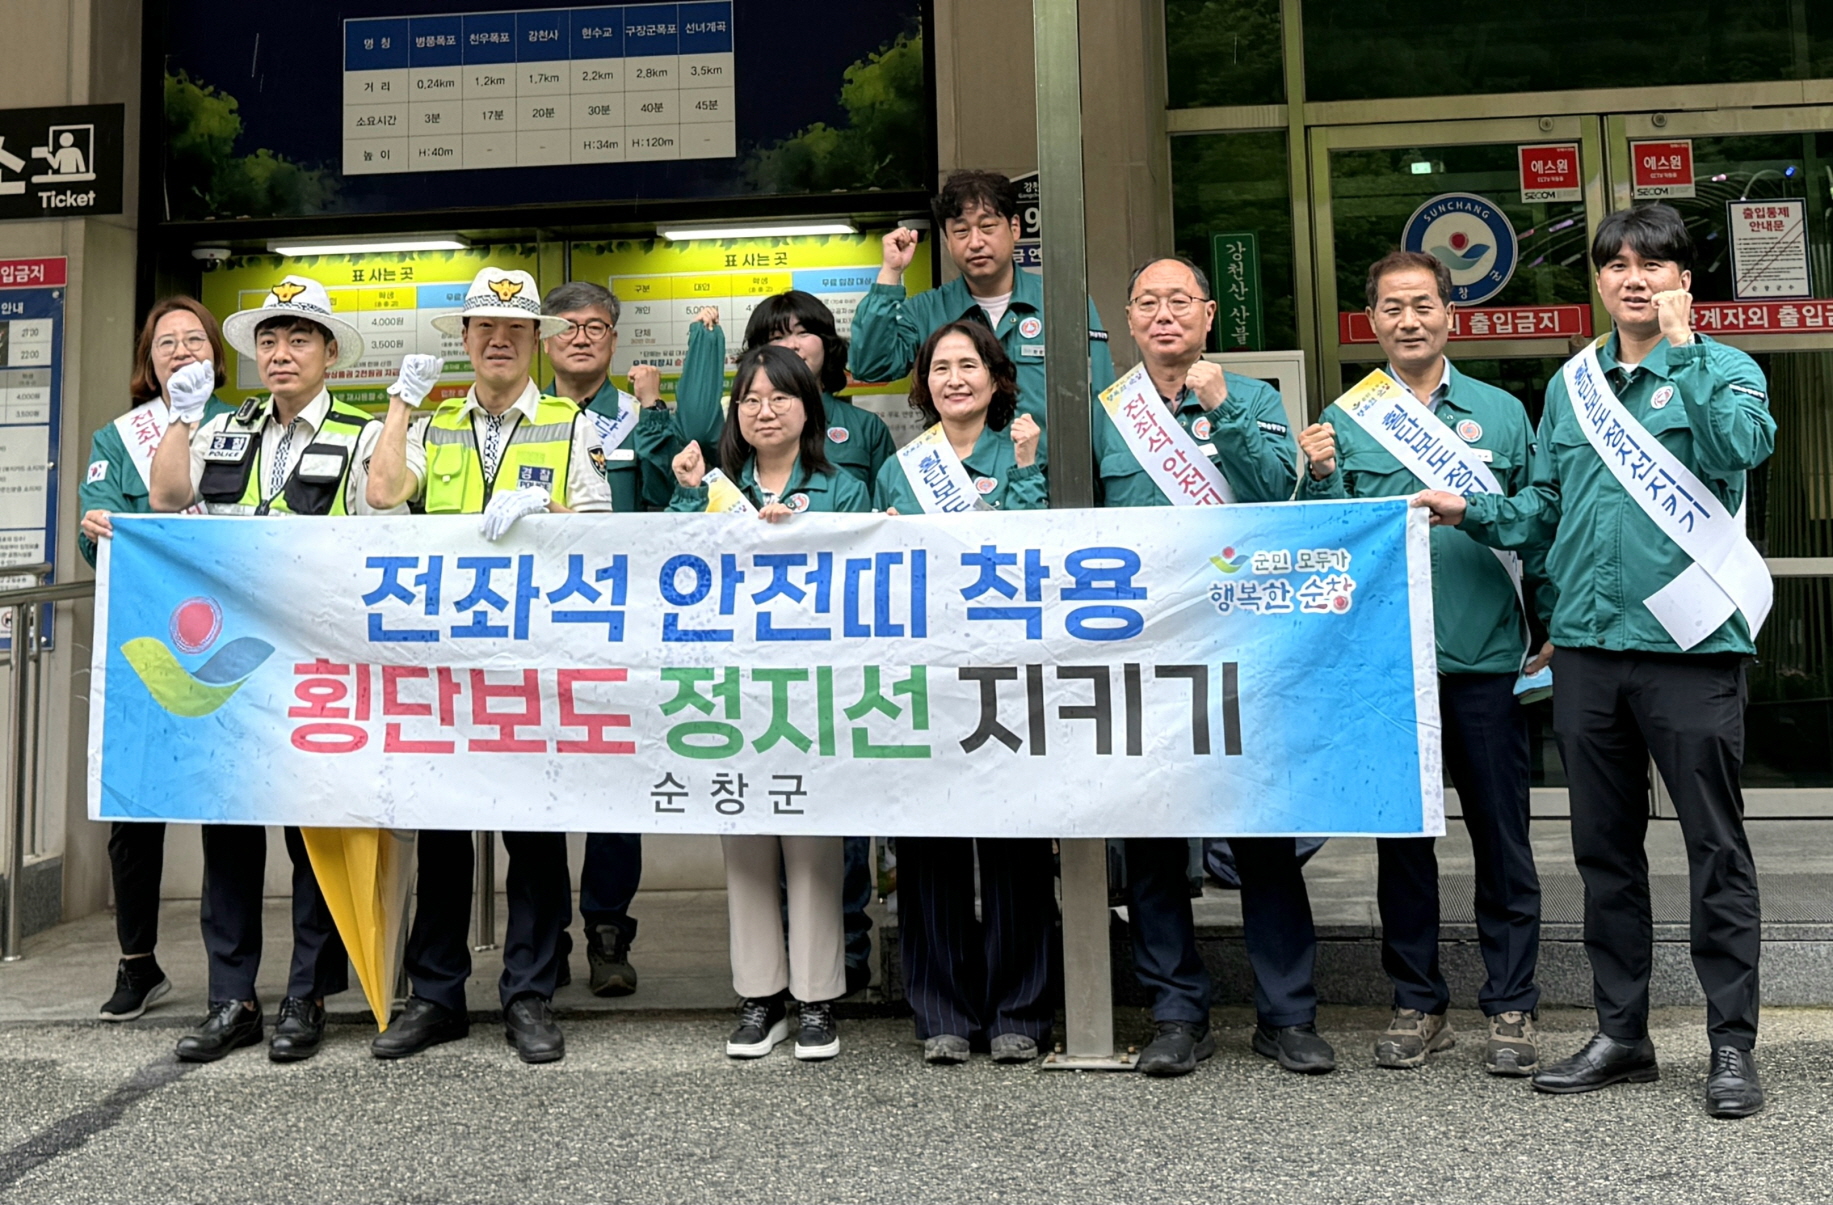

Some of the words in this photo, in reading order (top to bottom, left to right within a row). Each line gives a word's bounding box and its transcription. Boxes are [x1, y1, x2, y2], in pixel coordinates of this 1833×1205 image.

[528, 29, 559, 42] 강천사
[581, 27, 613, 39] 현수교
[625, 24, 677, 37] 구장군폭포
[685, 21, 727, 34] 선녀계곡
[417, 79, 455, 90] 0.24km
[475, 76, 505, 87] 1.2km
[529, 74, 559, 85] 1.7km
[582, 71, 614, 81] 2.2km
[636, 68, 668, 79] 2.8km
[690, 66, 723, 77] 3.5km
[356, 115, 397, 127] 소요시간
[424, 113, 441, 124] 3분
[482, 110, 504, 121] 17분
[532, 107, 555, 118] 20분
[587, 105, 611, 116] 30분
[640, 102, 664, 113] 40분
[694, 100, 719, 111] 45분
[418, 147, 453, 157] H:40m
[583, 140, 619, 150] H:34m
[632, 137, 674, 148] H:120m
[1531, 158, 1569, 174] 에스원
[1643, 155, 1682, 171] 에스원
[37, 190, 96, 209] Ticket
[1524, 191, 1556, 200] SECOM
[1637, 187, 1669, 196] SECOM
[1423, 201, 1490, 222] SUNCHANG
[1743, 206, 1790, 220] 출입통제
[1749, 220, 1785, 232] 안내문
[725, 254, 737, 267] 표
[742, 253, 770, 267] 사는
[774, 252, 788, 265] 곳
[0, 264, 45, 283] 입금지
[352, 269, 365, 282] 표
[369, 267, 396, 282] 사는
[400, 266, 414, 280] 곳
[1225, 241, 1249, 301] 강천산
[1, 302, 24, 315] 안내
[634, 306, 651, 315] 개인
[371, 317, 404, 326] 4,000원
[1469, 310, 1560, 335] 출입금지
[634, 328, 652, 338] 단체
[371, 340, 404, 349] 3,500원
[1123, 393, 1173, 453] 전좌석
[213, 436, 246, 451] 경찰
[1382, 403, 1456, 475] 횡단보도
[208, 450, 240, 458] POLICE
[521, 466, 551, 482] 경찰
[1603, 418, 1658, 480] 정지선
[1645, 468, 1711, 533] 지키기
[1254, 552, 1290, 572] 군민
[1298, 551, 1348, 570] 모두가
[361, 553, 628, 643] 전좌석
[658, 548, 927, 643] 안전띠
[959, 544, 1147, 642] 착용
[1209, 582, 1291, 613] 행복한
[1299, 576, 1353, 612] 순창
[288, 658, 636, 756] 횡단보도
[659, 664, 932, 759] 정지선
[958, 661, 1243, 757] 지키기
